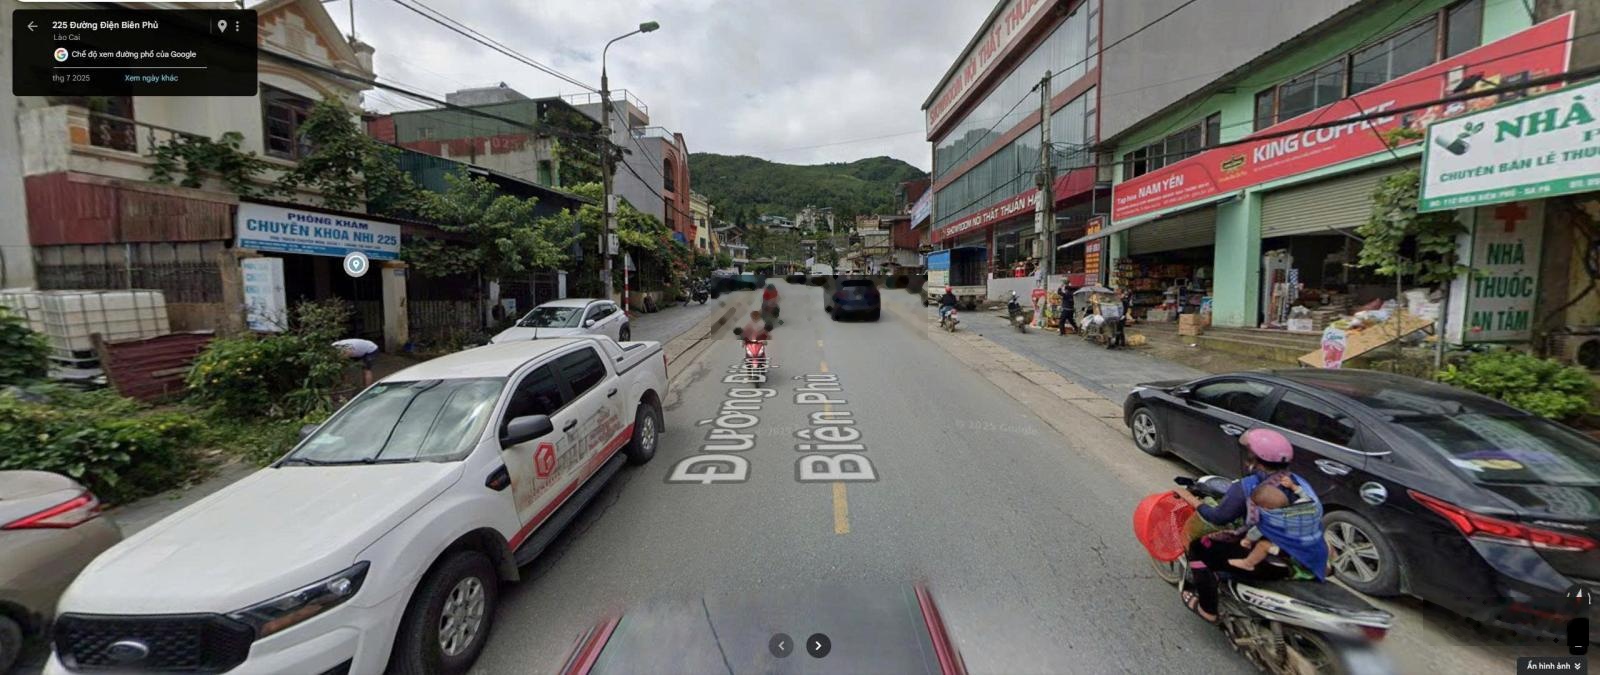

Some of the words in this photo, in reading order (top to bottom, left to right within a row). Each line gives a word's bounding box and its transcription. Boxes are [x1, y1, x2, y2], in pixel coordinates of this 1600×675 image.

[1005, 0, 1037, 35] THU
[1253, 134, 1299, 164] KING
[1302, 100, 1396, 148] COFFEE
[1495, 95, 1596, 143] NHÀ
[1439, 164, 1494, 182] CHUYÊN
[1499, 158, 1532, 173] BÁN
[1536, 151, 1557, 167] LẺ
[1562, 146, 1600, 162] THU
[1138, 182, 1161, 199] NAM
[246, 218, 310, 237] CHUYÊN
[314, 227, 350, 241] KHOA
[353, 231, 374, 243] NHI
[377, 234, 397, 246] 225
[288, 212, 332, 226] PHÒNG
[1487, 239, 1525, 265] NHÀ
[1474, 269, 1533, 298] THUỐC
[1471, 311, 1493, 331] AN
[1497, 307, 1529, 331] TÂM
